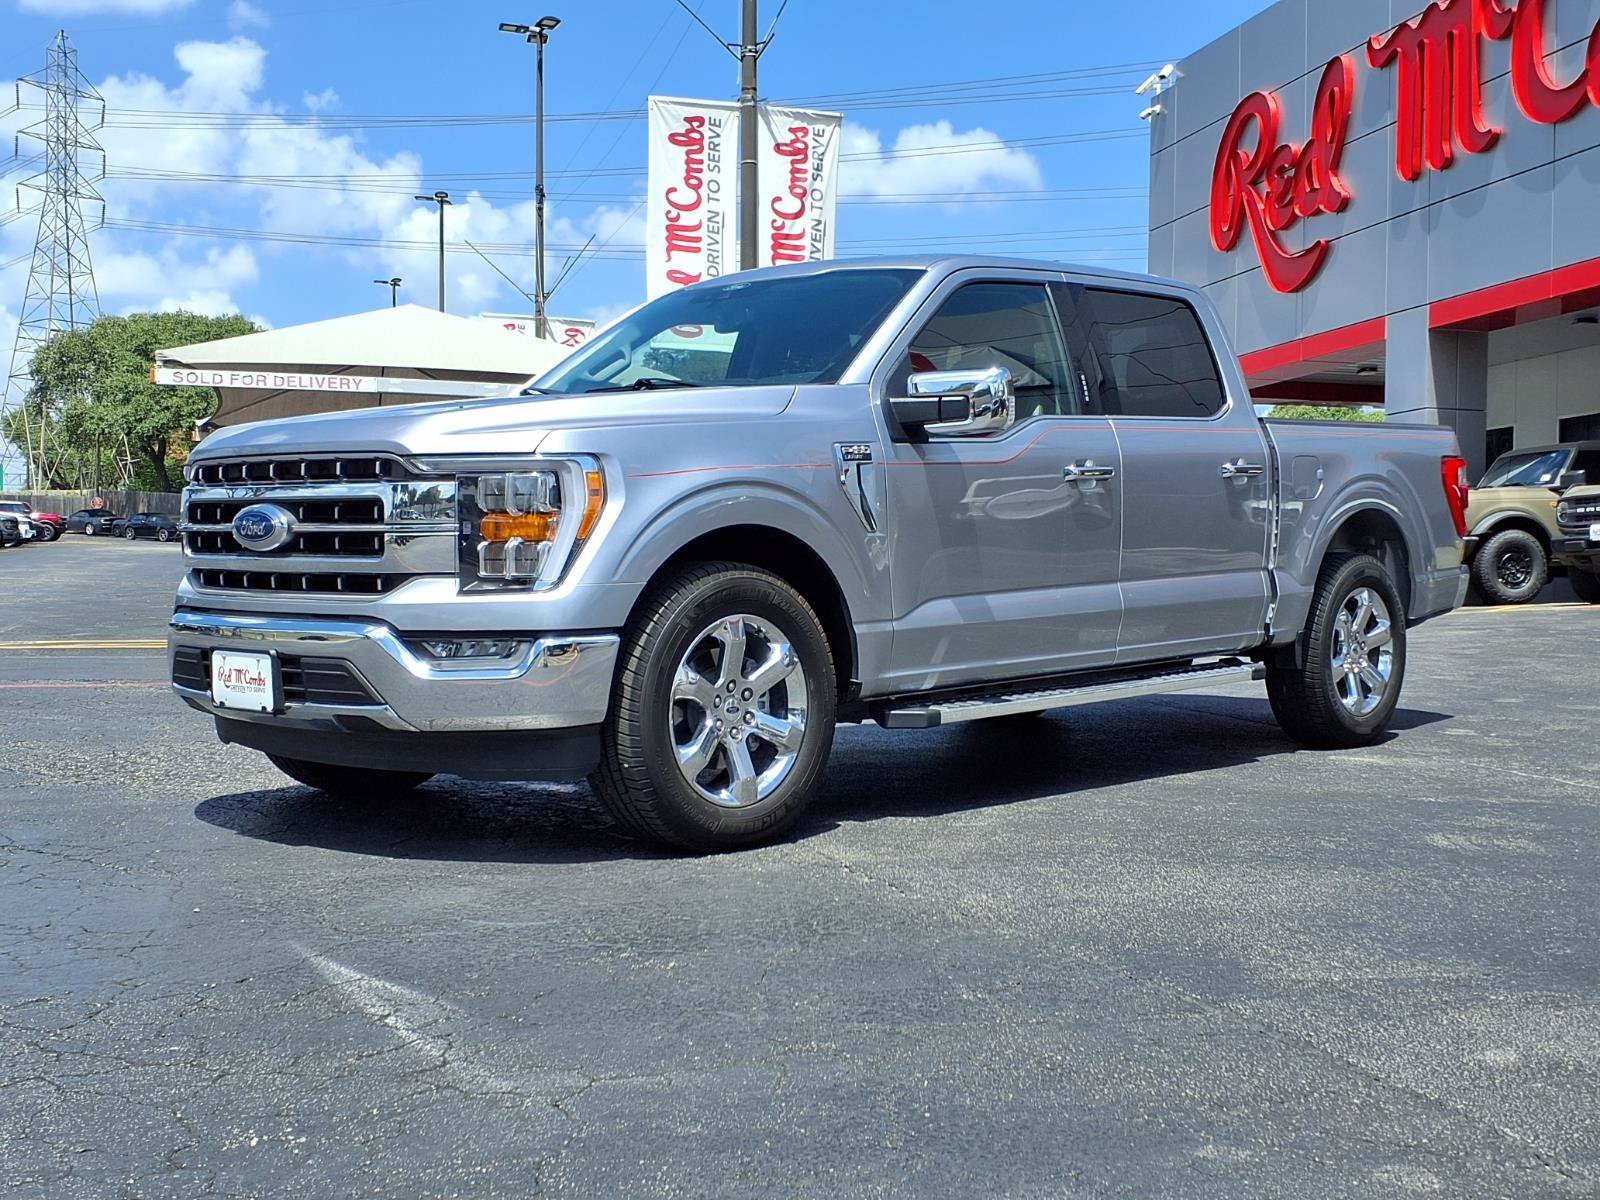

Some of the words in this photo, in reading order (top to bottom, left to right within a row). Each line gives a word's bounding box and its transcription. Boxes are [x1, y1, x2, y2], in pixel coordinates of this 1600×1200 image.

[707, 116, 722, 175] SERVE
[811, 126, 826, 182] SERVE
[1209, 54, 1353, 293] Red
[1366, 0, 1600, 182] McC
[665, 115, 706, 263] McCombs
[706, 179, 721, 204] TO
[770, 126, 810, 266] McCombs
[810, 188, 824, 212] TO
[706, 210, 720, 278] DRIVEN
[809, 218, 823, 261] IVEN
[172, 371, 224, 386] SOLD
[230, 373, 268, 387] FOR
[273, 375, 363, 391] DELIVERY
[240, 516, 267, 536] Ford
[218, 665, 232, 688] Red
[233, 668, 266, 687] McCombs
